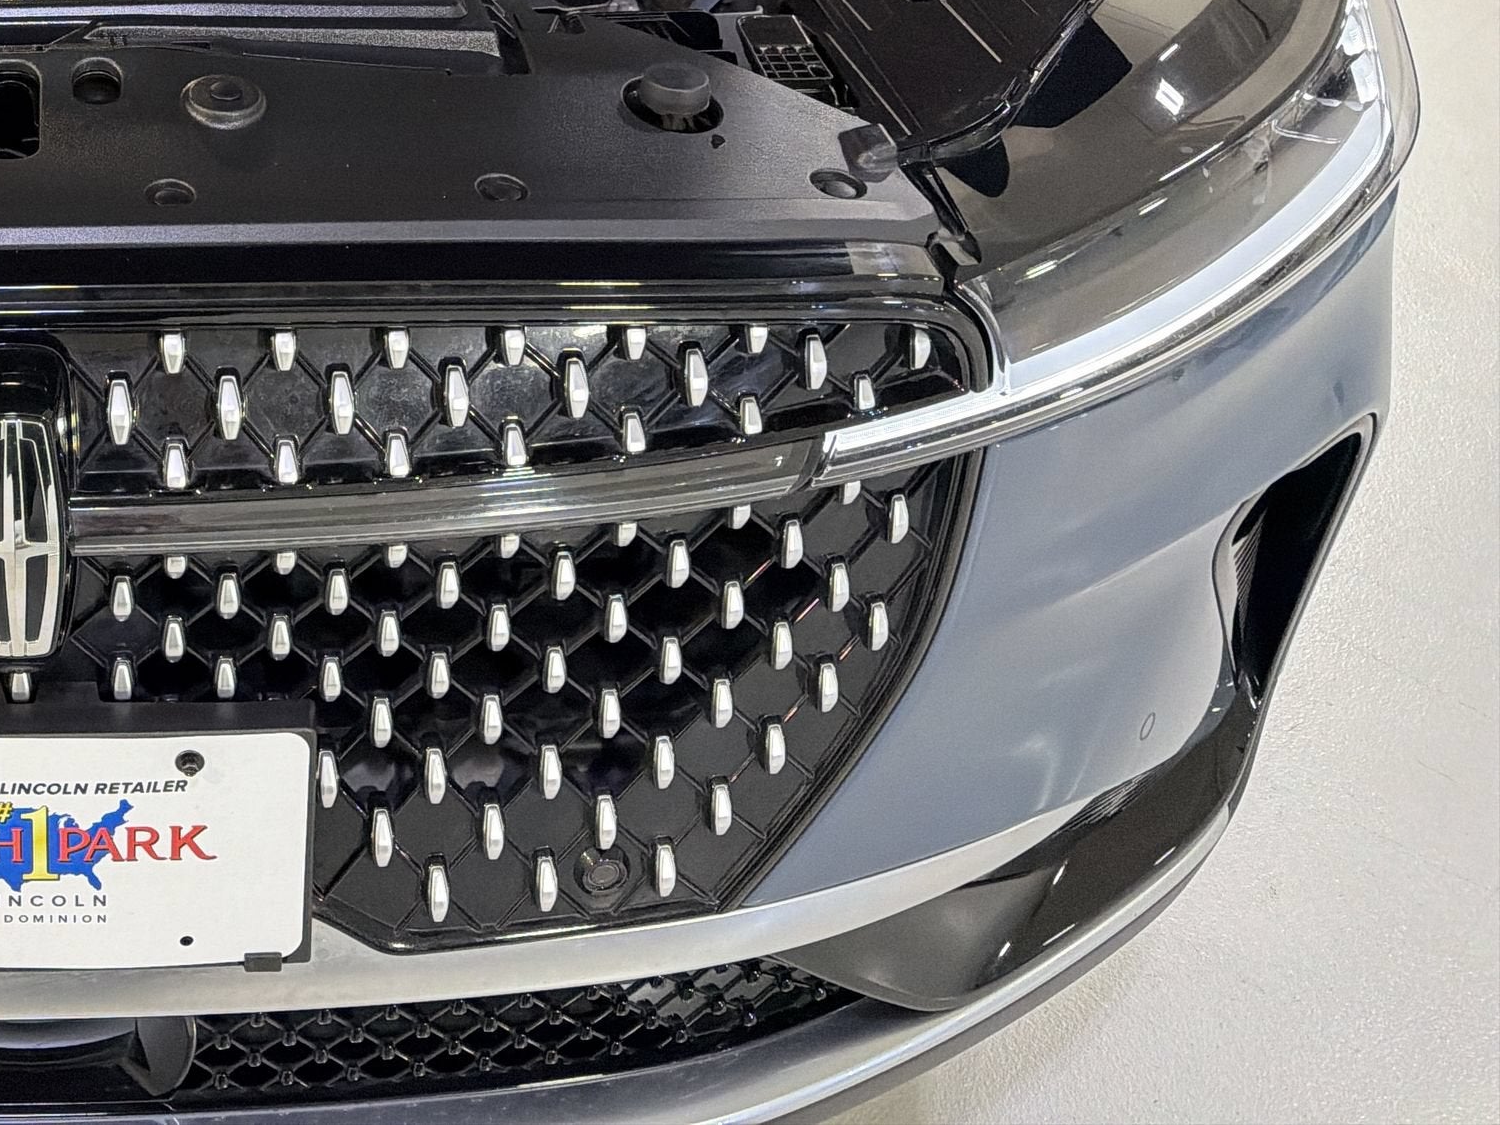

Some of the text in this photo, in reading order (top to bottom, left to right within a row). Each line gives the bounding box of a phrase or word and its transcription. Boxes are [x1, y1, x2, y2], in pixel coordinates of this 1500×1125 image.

[0, 782, 89, 795] LINCOLN
[94, 779, 188, 795] RETAILER
[57, 824, 218, 864] PARK
[4, 914, 107, 924] DOMINION
